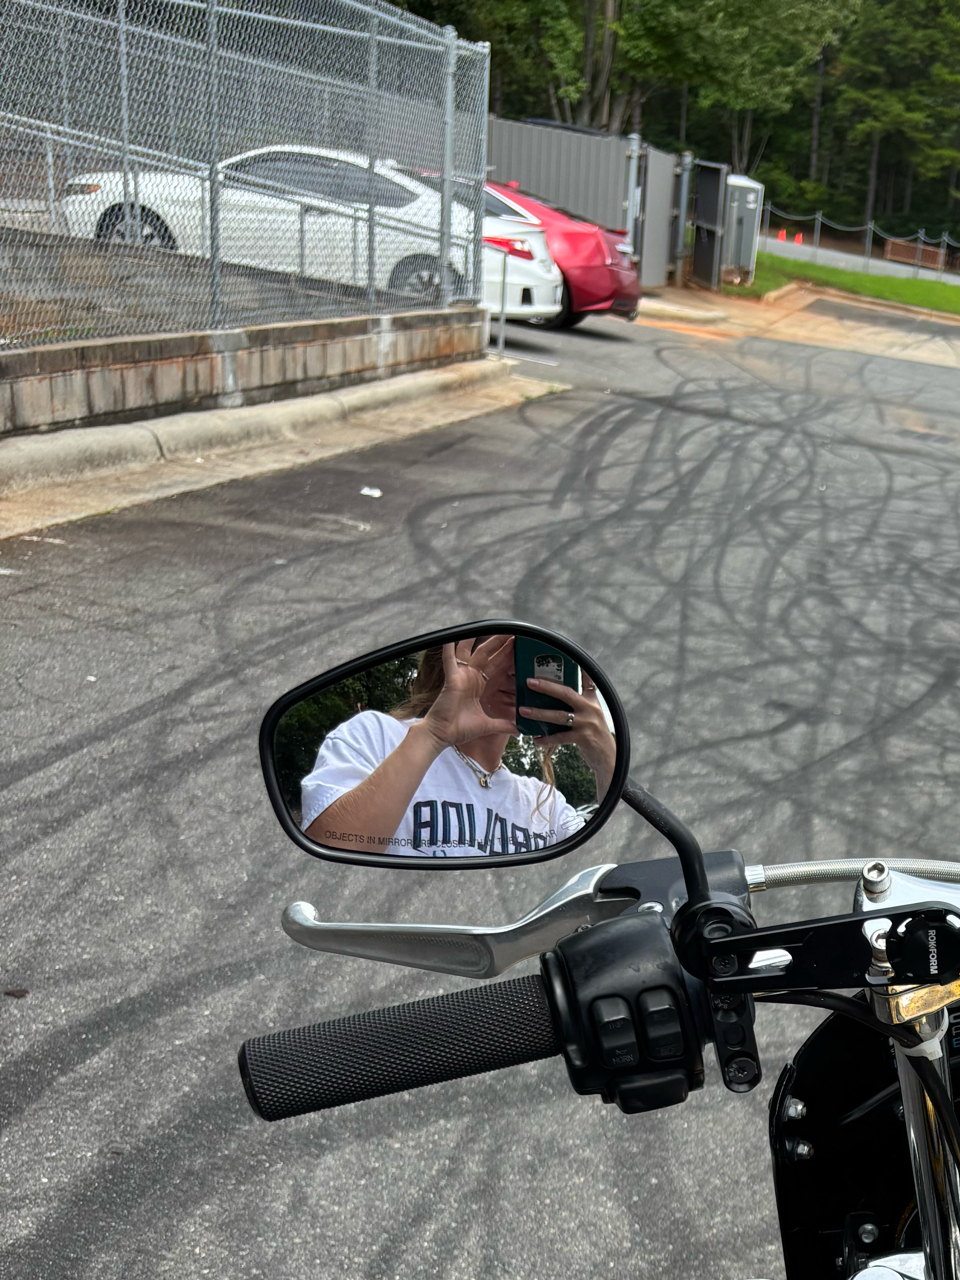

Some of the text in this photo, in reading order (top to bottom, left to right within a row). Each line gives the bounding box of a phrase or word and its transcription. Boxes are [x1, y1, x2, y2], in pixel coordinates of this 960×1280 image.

[324, 830, 365, 844] OBJECTS
[366, 836, 376, 845] IN
[377, 837, 413, 847] MIRROR
[928, 929, 939, 975] ROKFORM
[612, 1054, 634, 1064] HORN
